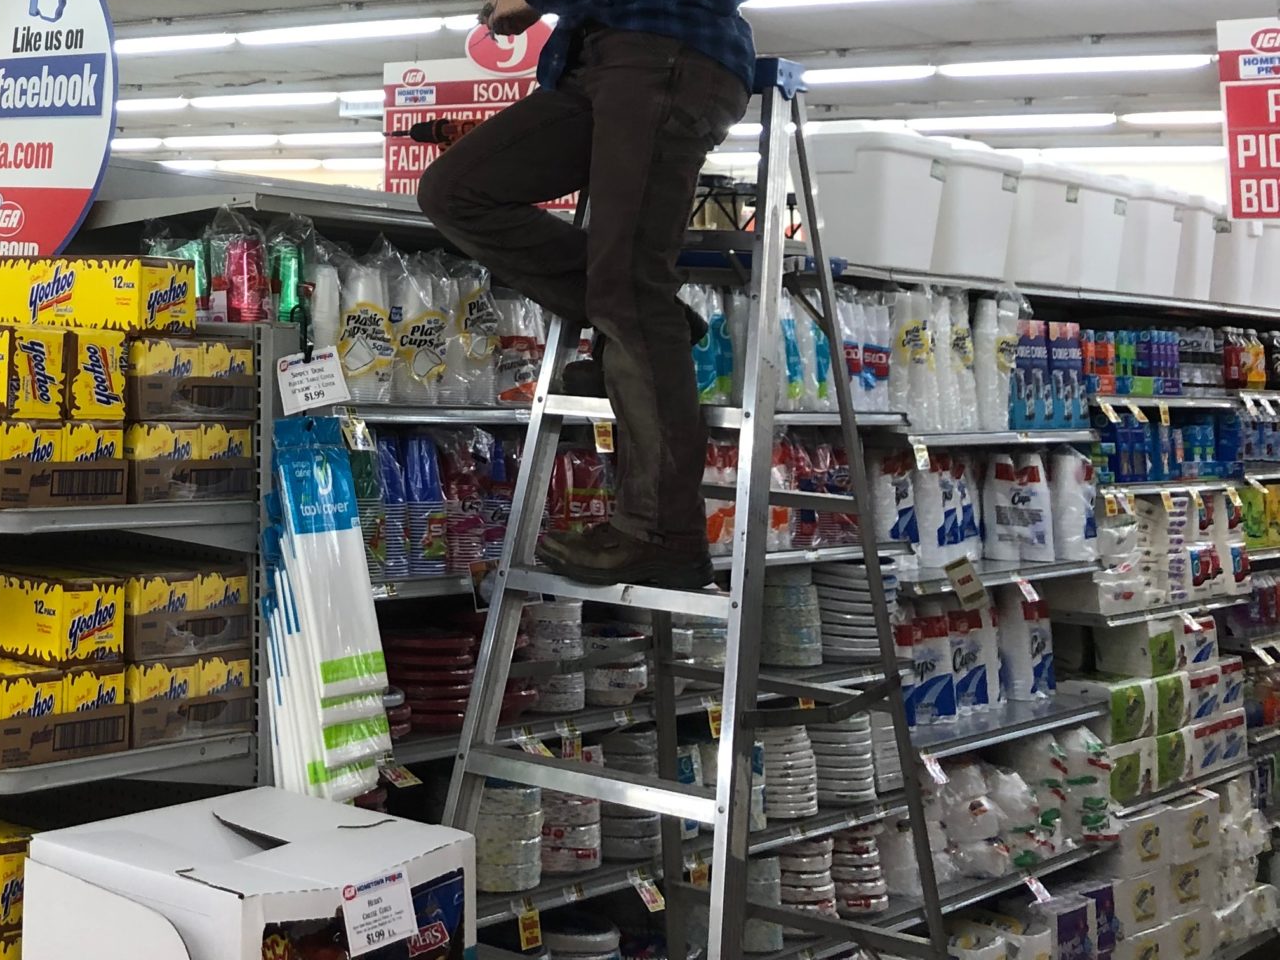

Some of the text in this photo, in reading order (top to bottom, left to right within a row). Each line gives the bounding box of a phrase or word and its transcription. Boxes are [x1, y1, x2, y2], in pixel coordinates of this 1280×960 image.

[13, 27, 84, 53] Like us on
[495, 34, 528, 68] 9
[1243, 57, 1280, 66] HOMET
[405, 71, 425, 83] IGA
[397, 88, 435, 97] HOMETOWN
[473, 82, 520, 102] ISOM
[389, 145, 439, 171] FACIA
[113, 276, 123, 289] 12
[347, 313, 384, 328] Plastic
[400, 334, 434, 348] Cups
[304, 390, 325, 401] $1.99
[34, 600, 56, 616] 12 PACK
[366, 930, 385, 945] $1.99
